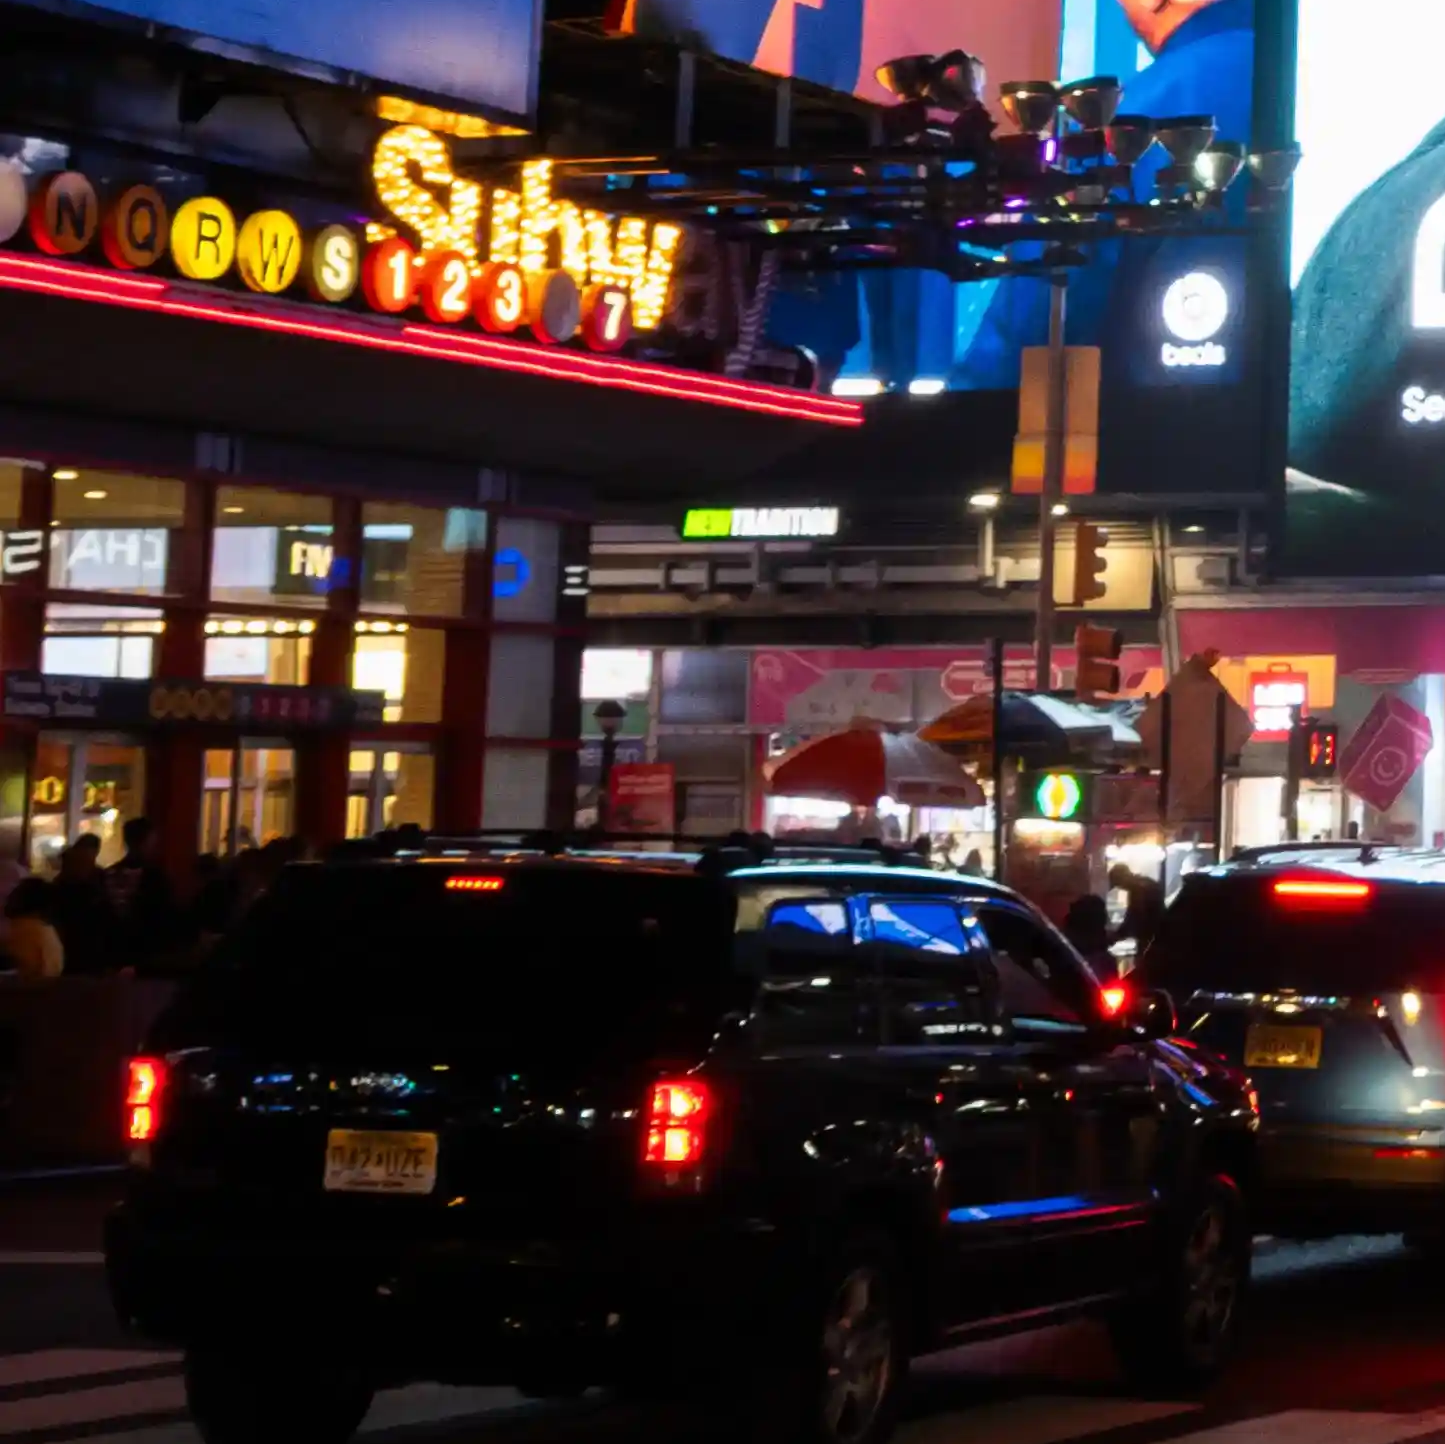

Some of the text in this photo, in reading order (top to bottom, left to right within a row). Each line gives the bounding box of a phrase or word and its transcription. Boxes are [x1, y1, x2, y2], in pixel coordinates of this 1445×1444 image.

[55, 191, 628, 342] N Q R W S 1 2 3 7
